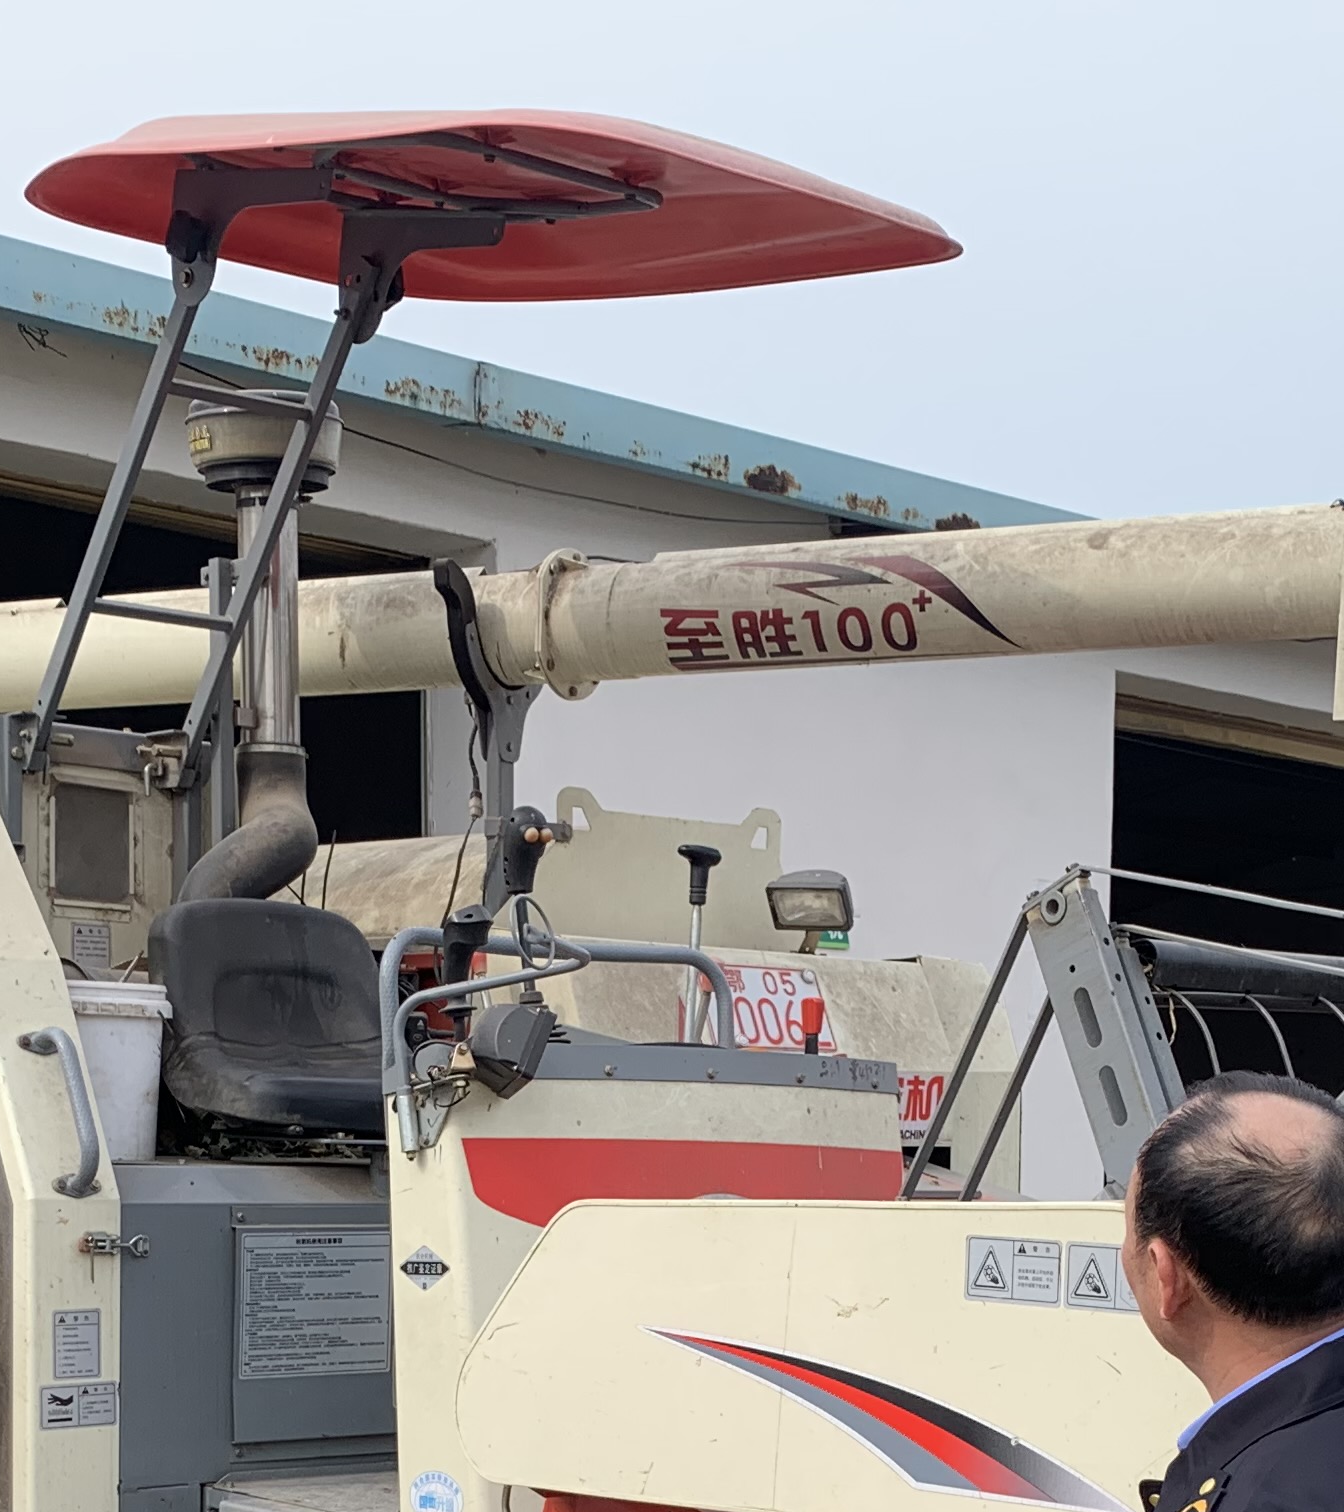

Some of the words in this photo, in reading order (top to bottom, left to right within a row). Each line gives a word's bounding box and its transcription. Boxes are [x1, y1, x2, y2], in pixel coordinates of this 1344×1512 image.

[762, 971, 797, 996] 05
[734, 996, 833, 1046] 006
[898, 1075, 945, 1121] 机
